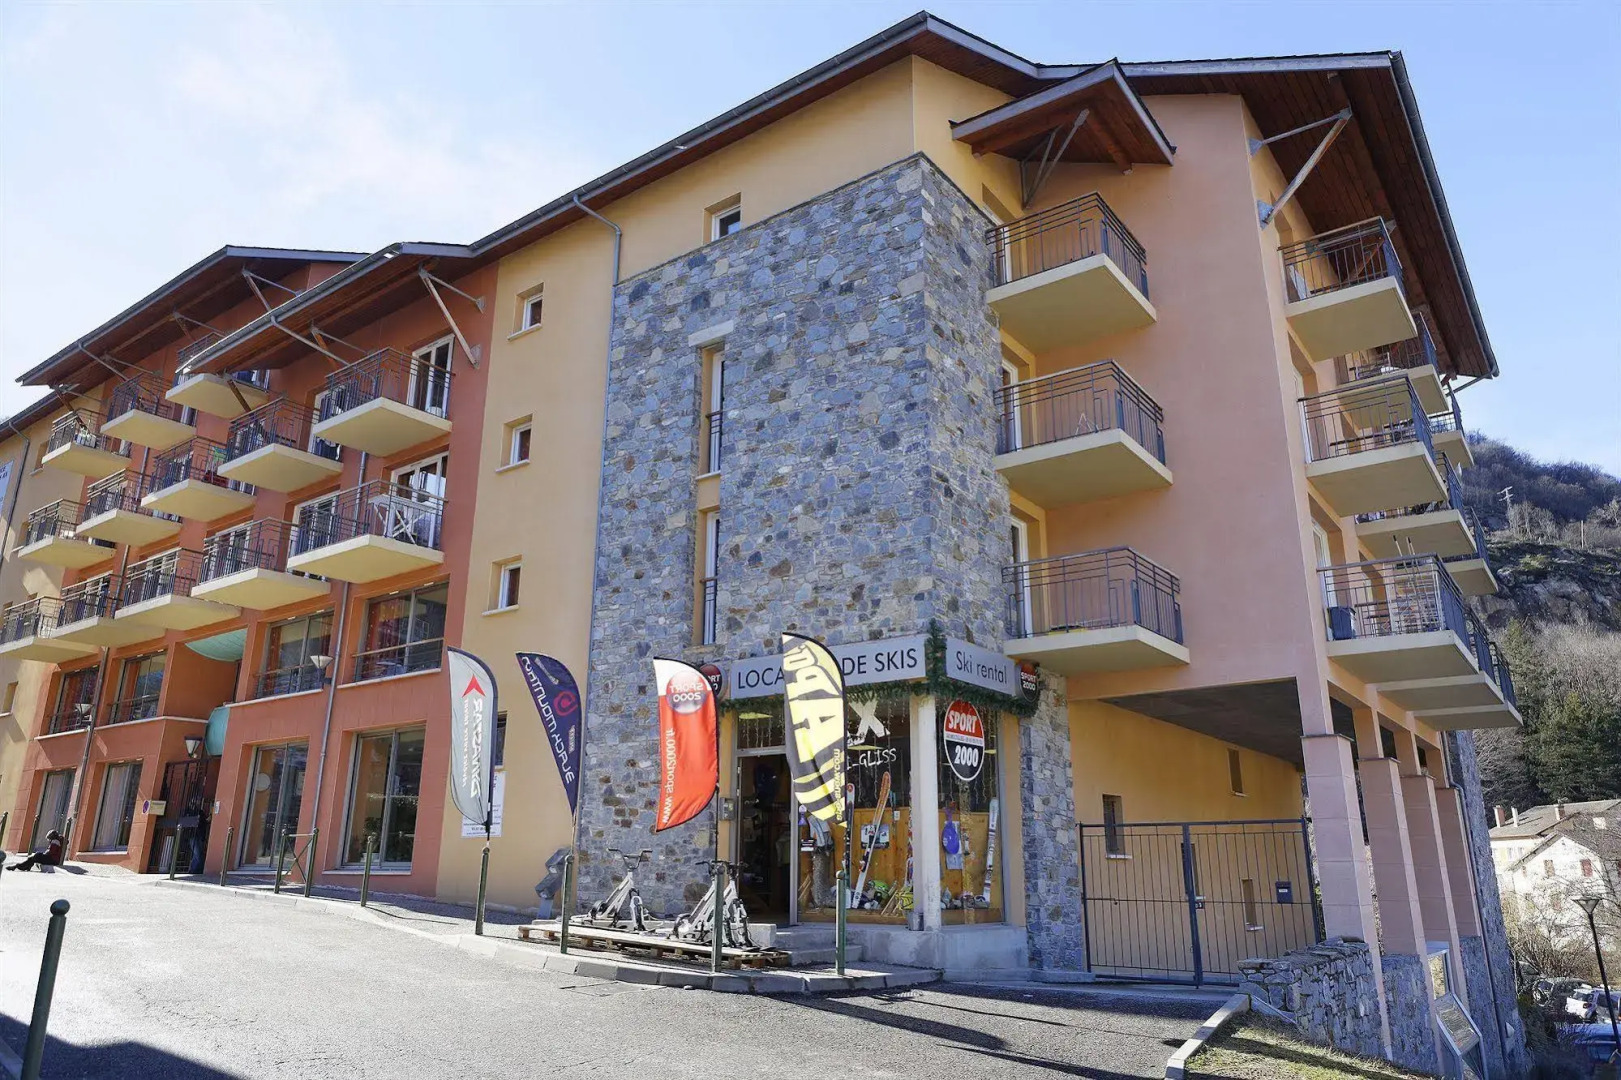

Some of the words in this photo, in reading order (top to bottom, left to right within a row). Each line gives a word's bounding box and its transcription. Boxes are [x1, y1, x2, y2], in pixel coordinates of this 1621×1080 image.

[738, 667, 784, 689] LOCA
[842, 655, 867, 676] DE
[874, 648, 917, 672] SKIS
[956, 651, 972, 674] Ski
[977, 663, 1007, 685] rental
[1021, 671, 1036, 682] SPORT
[1023, 680, 1035, 691] 2000
[948, 710, 977, 733] SPORT
[954, 745, 979, 767] 2000
